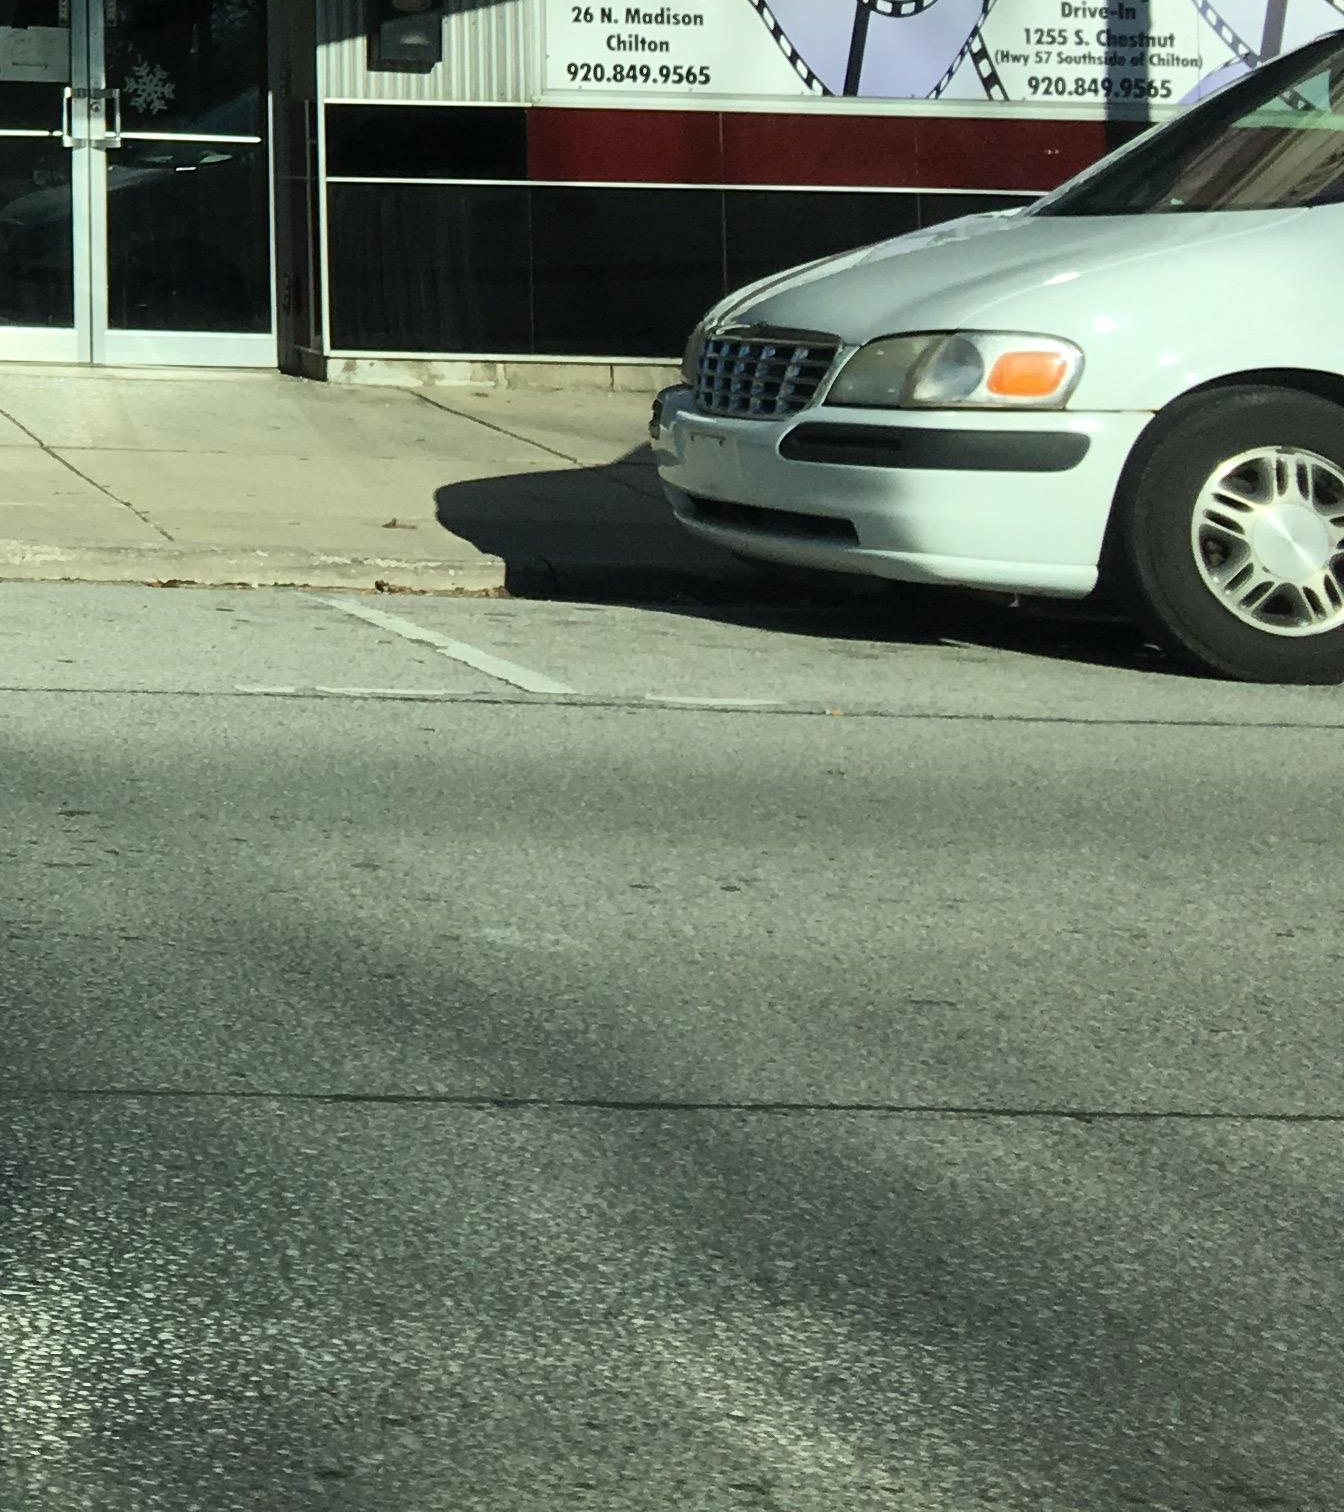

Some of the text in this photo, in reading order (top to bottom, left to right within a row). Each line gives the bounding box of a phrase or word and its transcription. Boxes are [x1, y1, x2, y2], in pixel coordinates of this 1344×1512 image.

[571, 5, 704, 26] 26 N. Madison
[1061, 1, 1137, 20] Drive-In
[606, 34, 670, 53] Chilton
[1023, 27, 1175, 48] 1255 S. Chestnut
[994, 49, 1030, 67] (Hwy
[1034, 50, 1052, 64] 57
[1057, 51, 1126, 68] Southside
[1149, 53, 1204, 69] Chilton)
[566, 61, 712, 86] 920.849.9565
[1027, 76, 1173, 99] 920.849.9565
